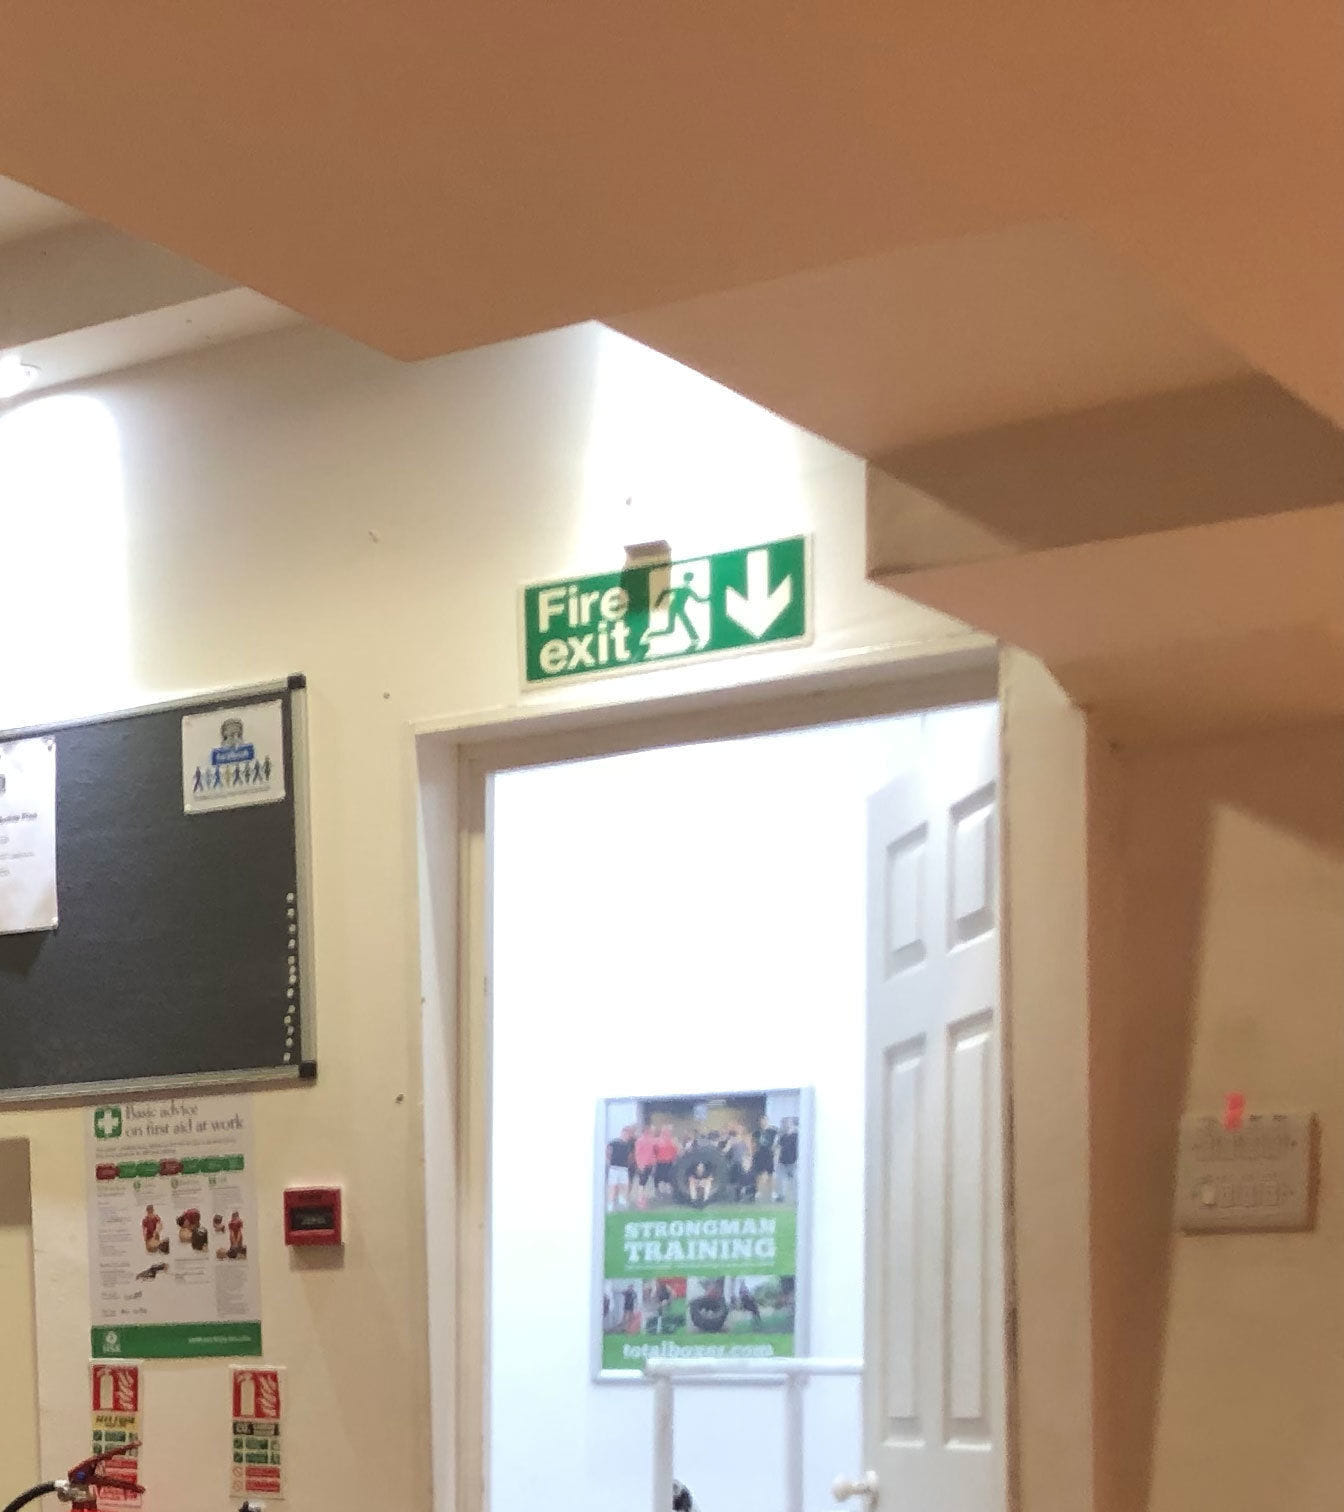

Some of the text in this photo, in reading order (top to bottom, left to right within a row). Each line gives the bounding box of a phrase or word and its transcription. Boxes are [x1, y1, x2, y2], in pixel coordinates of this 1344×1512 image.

[537, 584, 629, 634] Fire
[539, 620, 631, 675] exit
[125, 1099, 199, 1120] Basic advice
[125, 1113, 243, 1138] on first aid at work
[624, 1218, 777, 1239] STRONGMAN
[624, 1237, 777, 1263] TRAINING
